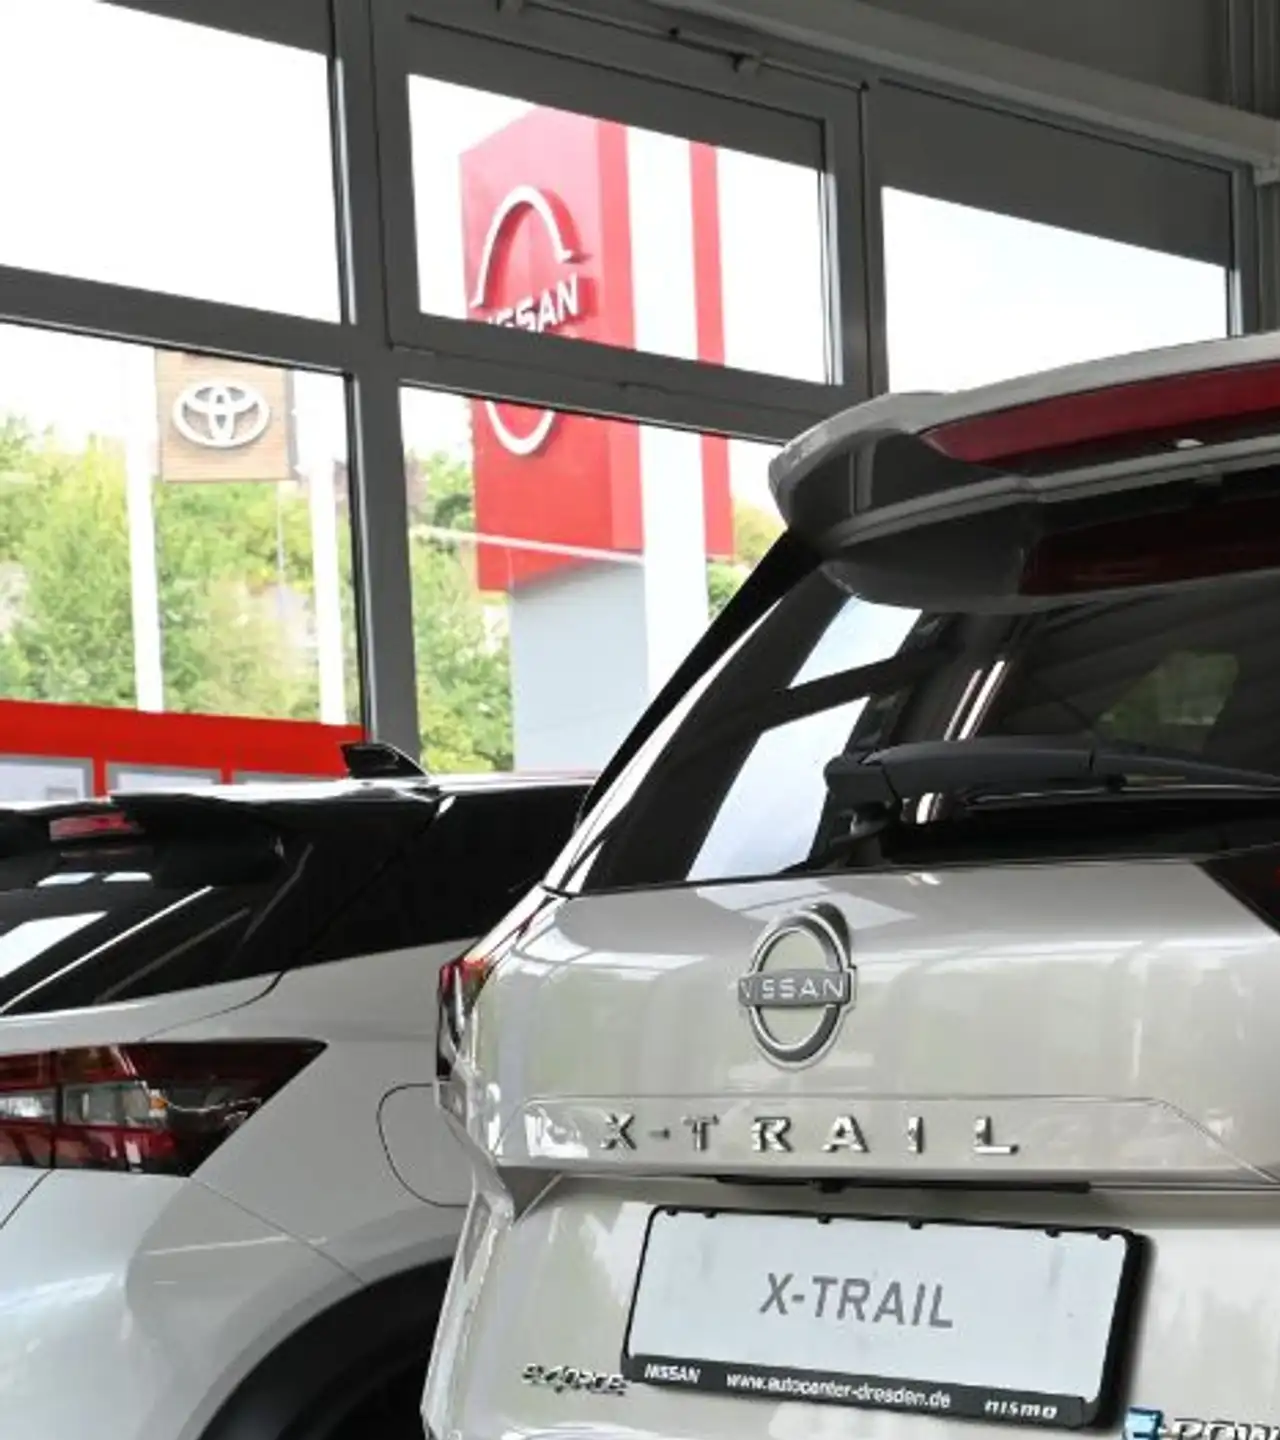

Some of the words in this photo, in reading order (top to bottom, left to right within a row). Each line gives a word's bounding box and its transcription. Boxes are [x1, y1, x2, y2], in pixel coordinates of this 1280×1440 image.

[602, 1113, 1019, 1154] X-TRAIL
[759, 1272, 953, 1328] X-TRAIL
[644, 1363, 701, 1383] NISSAN
[726, 1373, 951, 1409] www.autocenter-dresden.de
